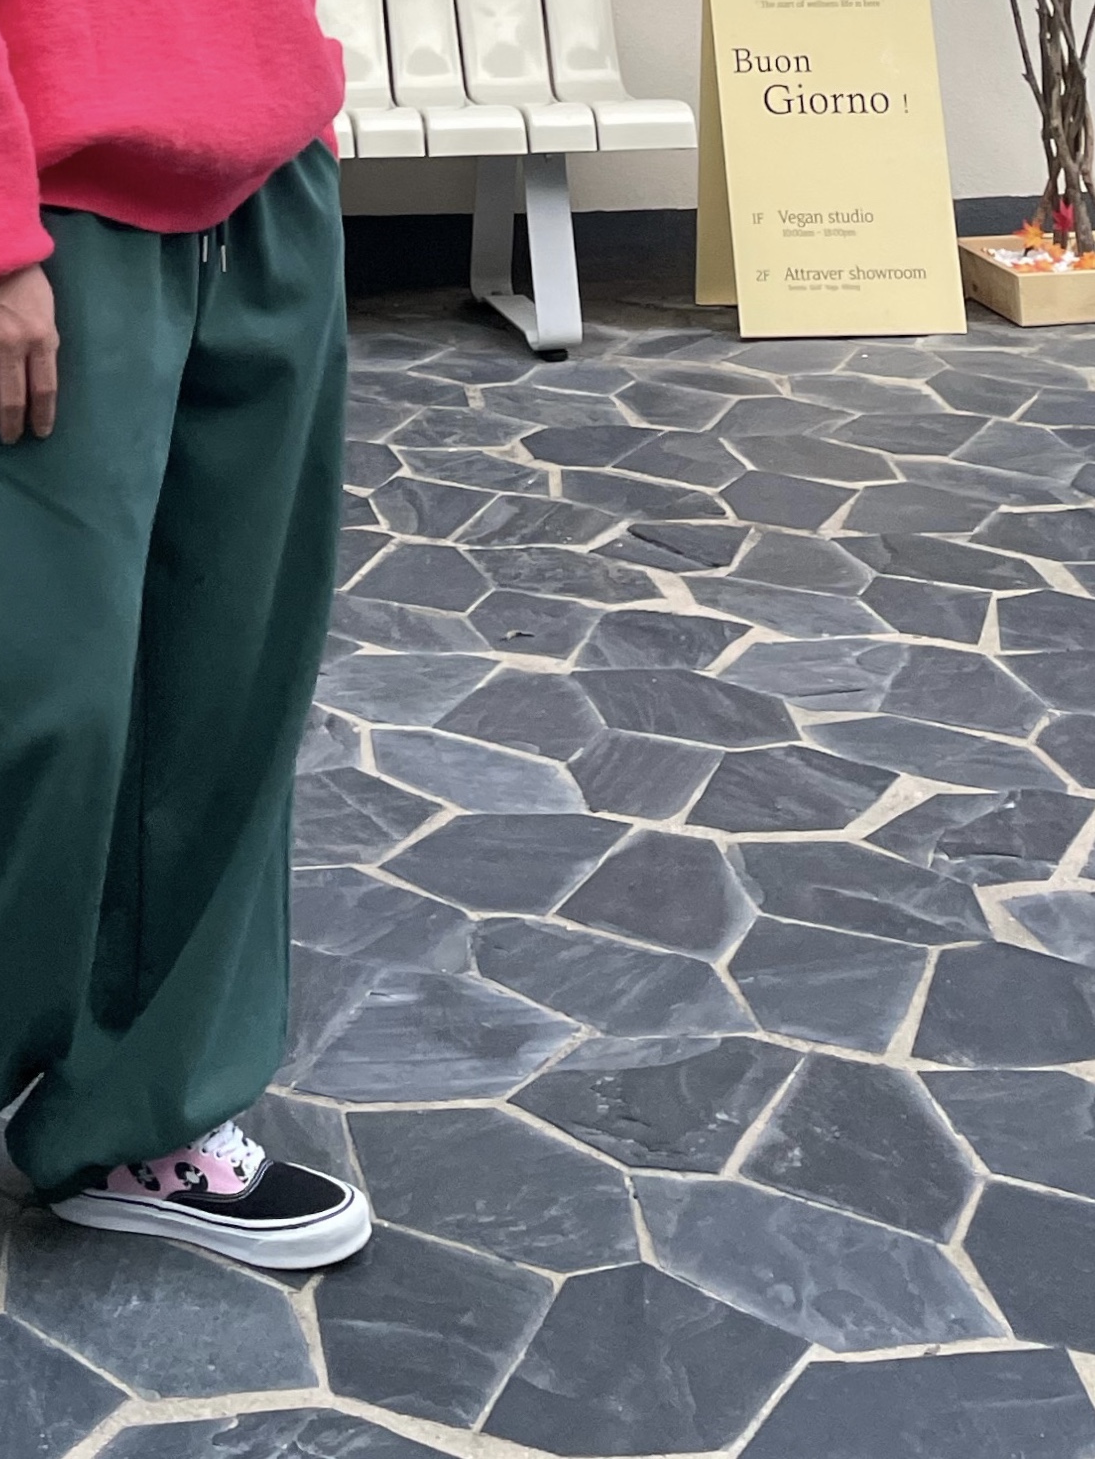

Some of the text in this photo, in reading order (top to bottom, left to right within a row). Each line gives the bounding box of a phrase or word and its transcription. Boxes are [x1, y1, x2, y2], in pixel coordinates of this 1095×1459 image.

[731, 47, 813, 74] Buon
[763, 83, 890, 115] Giorno
[778, 209, 824, 228] Vegan
[828, 208, 874, 224] studio
[756, 264, 927, 282] 2F Attraver showroom
